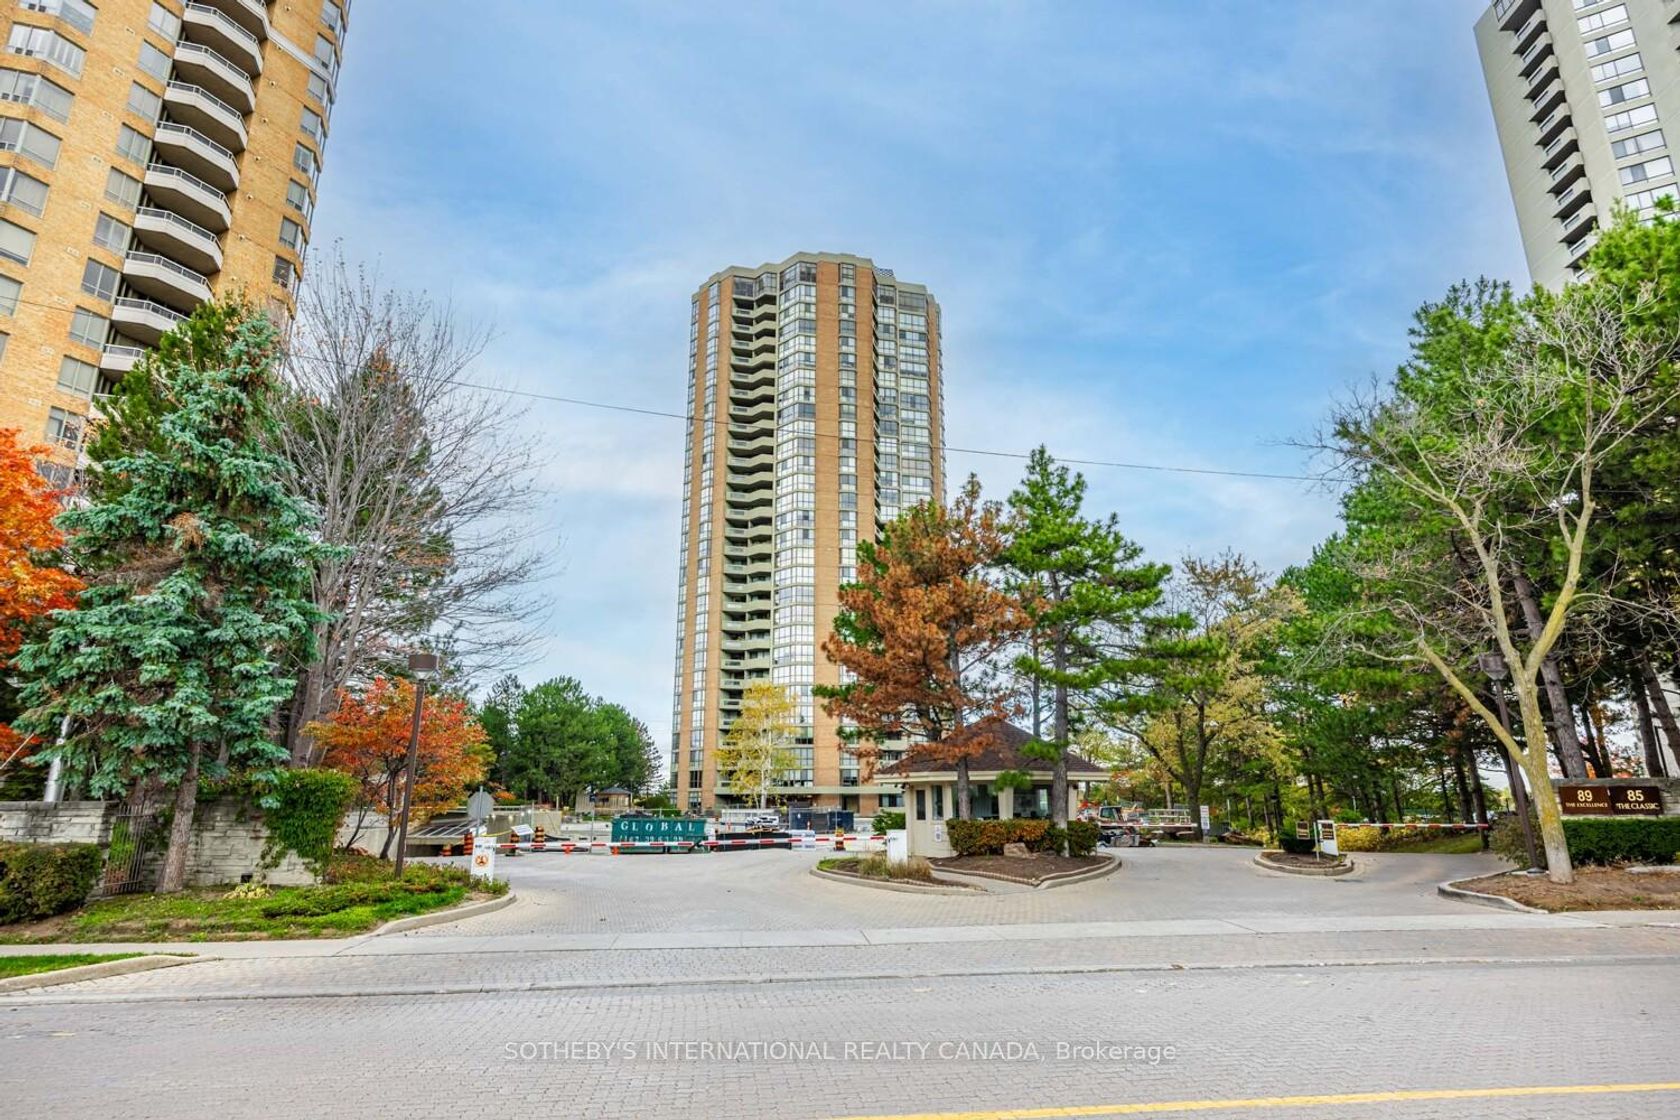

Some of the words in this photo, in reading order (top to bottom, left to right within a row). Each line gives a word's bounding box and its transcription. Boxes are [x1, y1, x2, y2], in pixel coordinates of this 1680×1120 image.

[1577, 790, 1593, 801] 89
[1627, 790, 1644, 801] 85
[621, 821, 695, 832] GLOBAL
